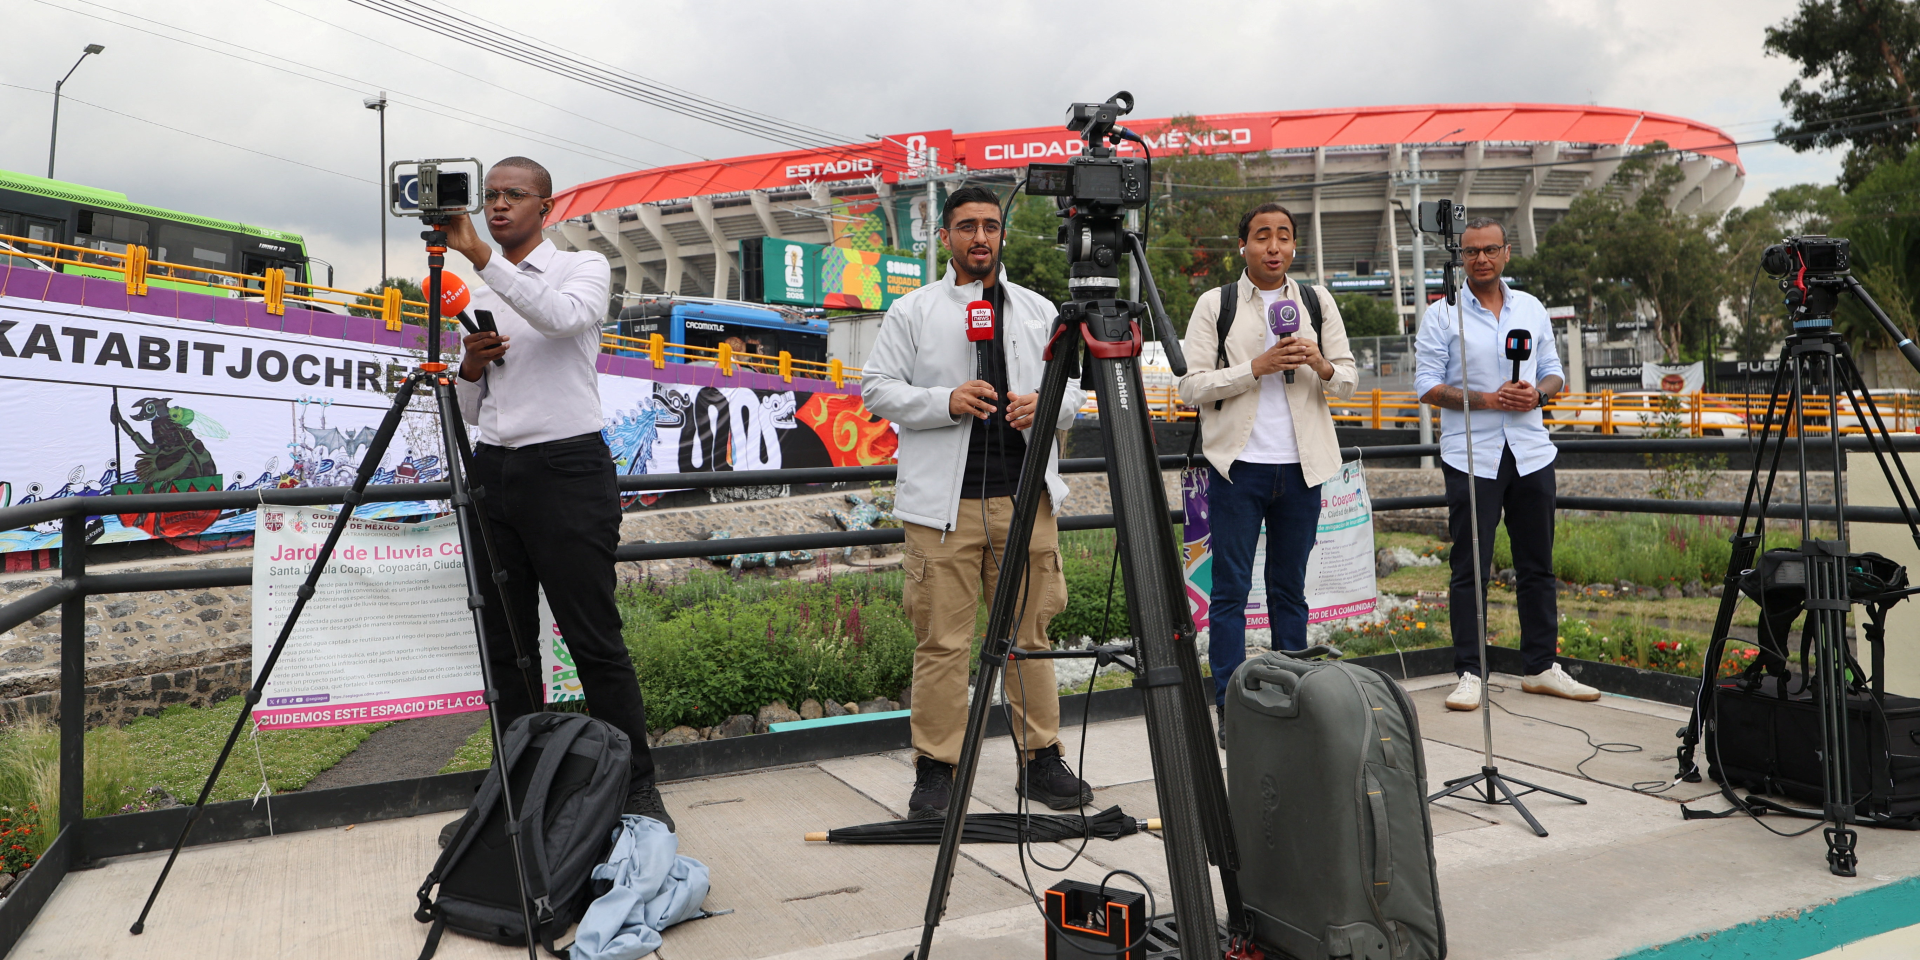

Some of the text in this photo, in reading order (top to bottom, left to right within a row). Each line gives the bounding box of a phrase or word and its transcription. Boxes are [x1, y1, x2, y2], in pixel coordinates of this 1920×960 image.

[984, 139, 1083, 161] CIUDAD
[1143, 128, 1251, 149] MÉXICO
[785, 158, 873, 179] ESTADIO
[260, 228, 282, 239] 1972
[887, 275, 921, 287] CIUDAD DE
[446, 284, 466, 305] MONDE
[686, 321, 724, 332] CACOMIXTLE
[1115, 362, 1129, 410] sachtler
[1328, 510, 1343, 518] Ciudad
[343, 545, 368, 560] de
[374, 544, 433, 561] Lluvia
[270, 564, 300, 576] Santa
[304, 562, 337, 574] Úula
[340, 564, 375, 577] Coapa,
[378, 562, 431, 577] Coyoacán,
[355, 580, 383, 588] mitigación
[407, 585, 422, 593] jardín
[313, 603, 331, 611] captar
[395, 611, 435, 620] pretratamiento
[330, 622, 361, 632] descargada
[286, 641, 302, 650] parte
[329, 638, 351, 646] captada
[402, 633, 415, 641] riego
[426, 631, 444, 639] propio
[445, 630, 462, 638] jardín,
[298, 647, 321, 656] potable.
[337, 651, 365, 660] hidráulica,
[379, 648, 395, 657] jardín
[396, 647, 414, 656] aporta
[401, 653, 427, 661] reducción
[436, 649, 474, 658] escurrimientos
[303, 676, 328, 685] proyecto
[367, 670, 401, 679] desarrollado
[410, 666, 444, 675] colaboración
[312, 668, 345, 676] comunidad.
[310, 683, 330, 692] Coapa,
[375, 675, 426, 687] corresponsabilidad
[261, 711, 331, 725] CUIDEMOS
[335, 707, 367, 720] ESTE
[371, 702, 425, 716] ESPACIO
[428, 700, 444, 710] DE
[448, 698, 463, 708] LA
